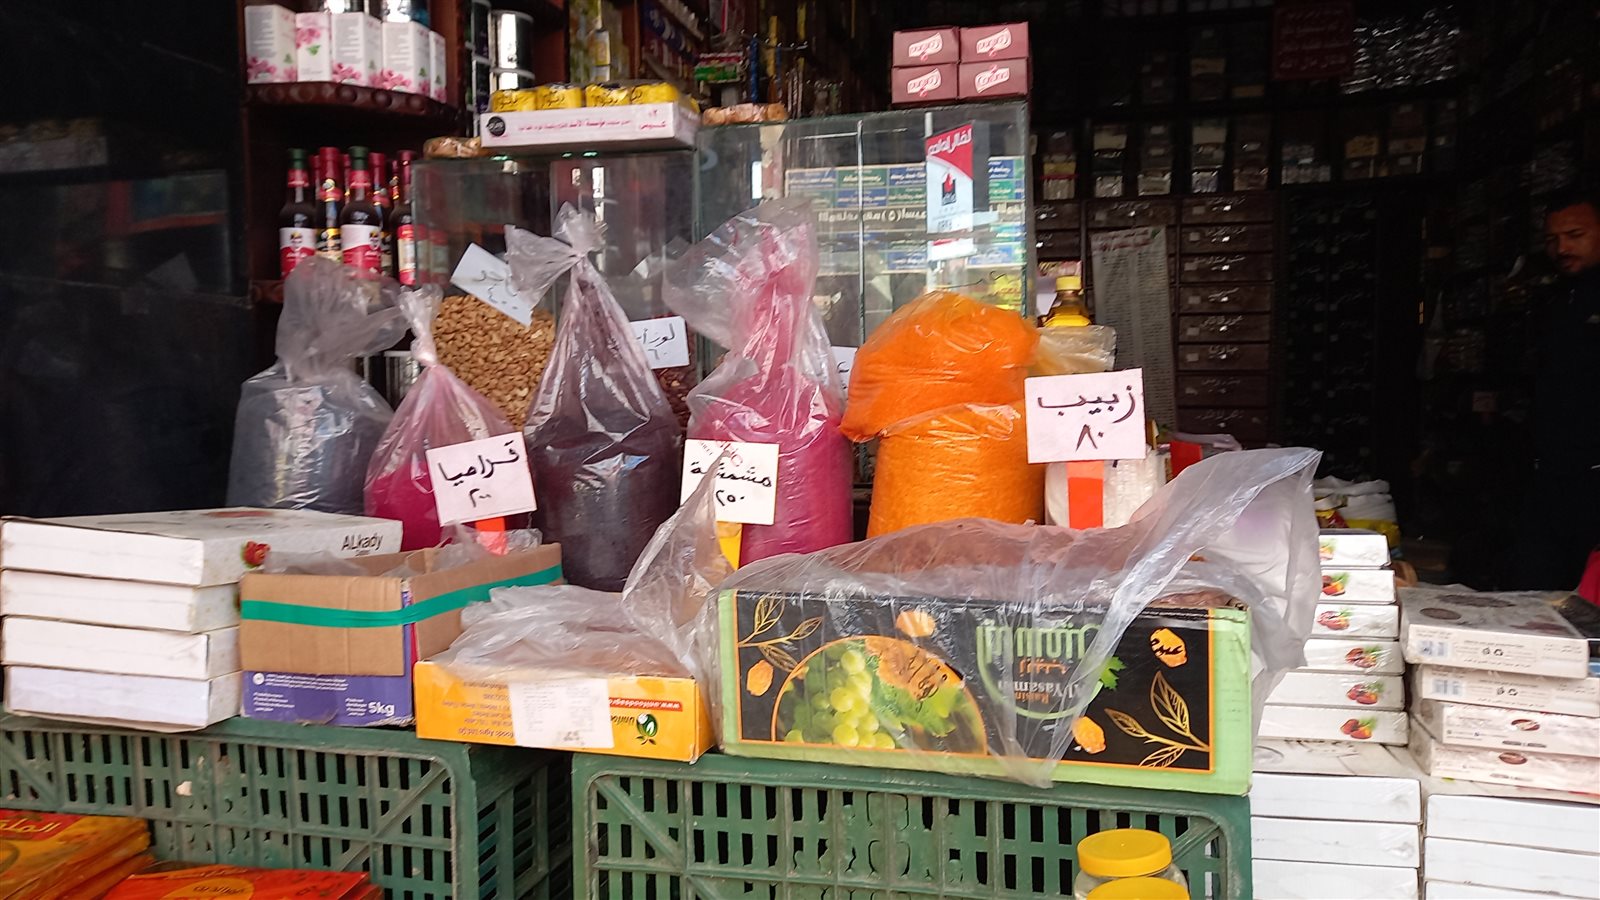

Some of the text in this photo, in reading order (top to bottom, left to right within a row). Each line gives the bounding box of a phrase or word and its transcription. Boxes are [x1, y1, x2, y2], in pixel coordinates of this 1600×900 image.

[1037, 384, 1137, 425] زبيب
[1075, 424, 1105, 451] ٨٠
[715, 489, 745, 507] ٢٥٠
[367, 700, 395, 718] 5kg
